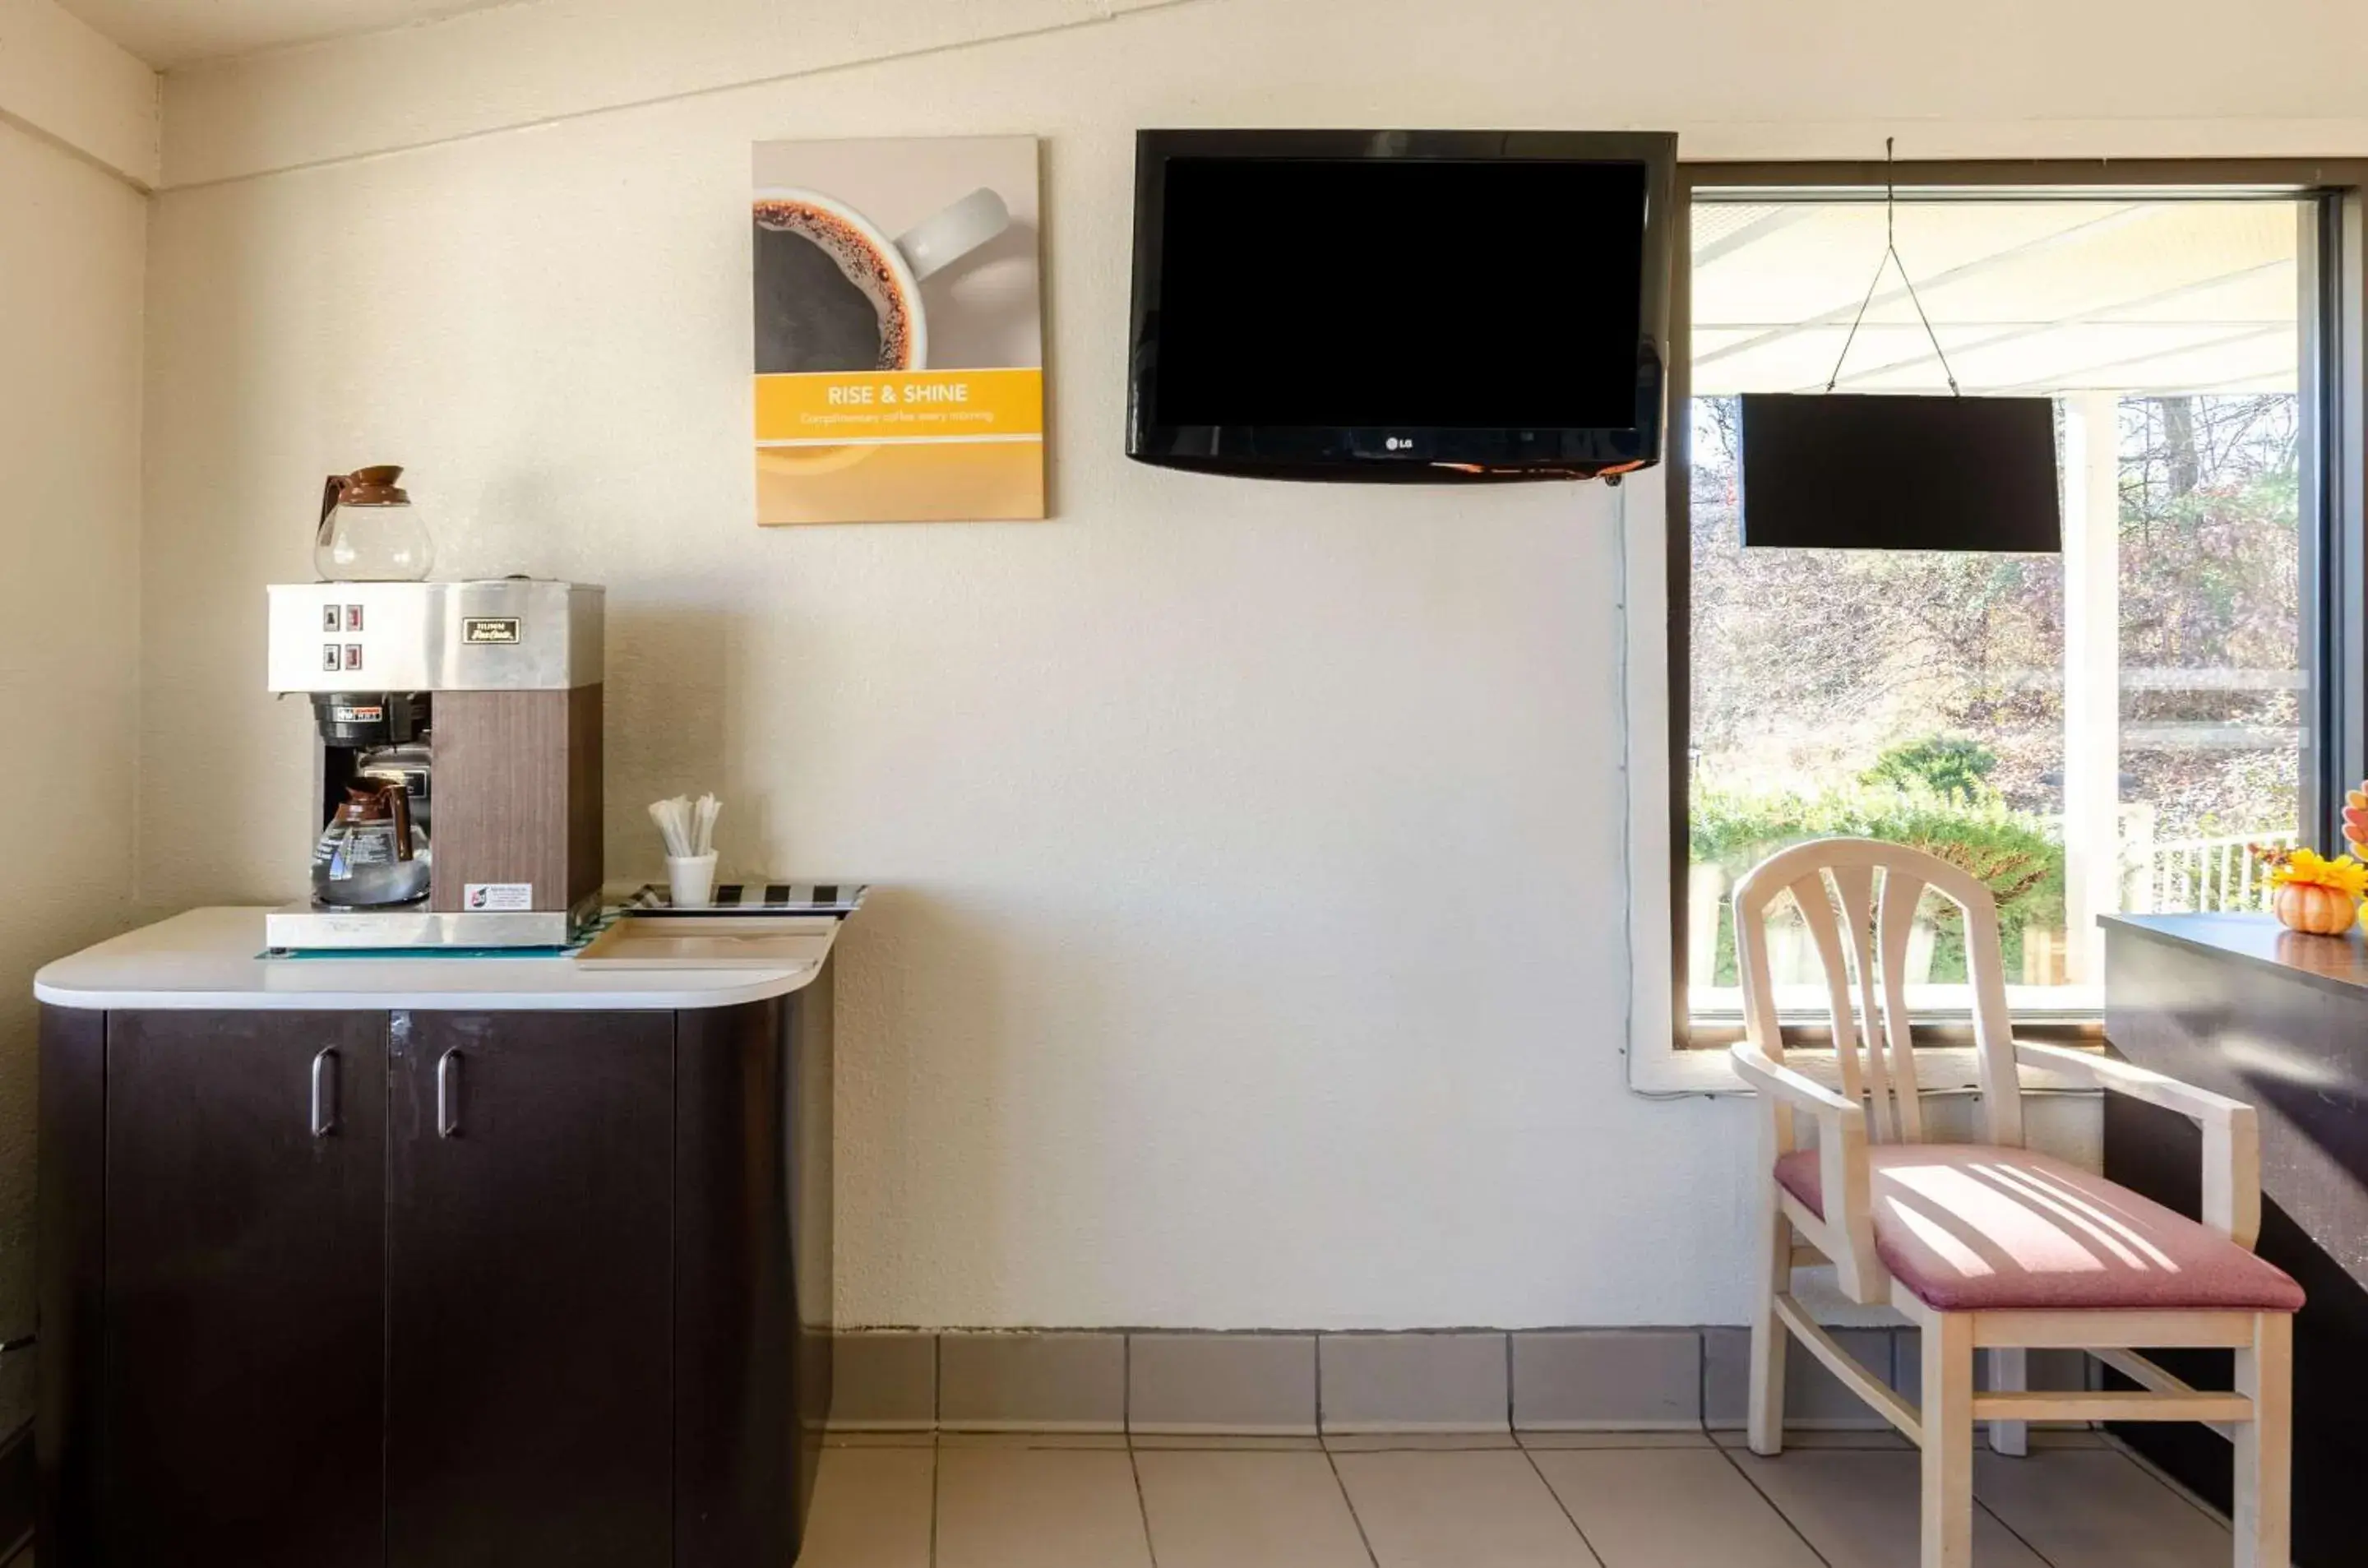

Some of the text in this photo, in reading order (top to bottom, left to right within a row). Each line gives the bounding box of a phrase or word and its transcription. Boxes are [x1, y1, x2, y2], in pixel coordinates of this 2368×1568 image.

[828, 383, 968, 405] RISE & SHINE
